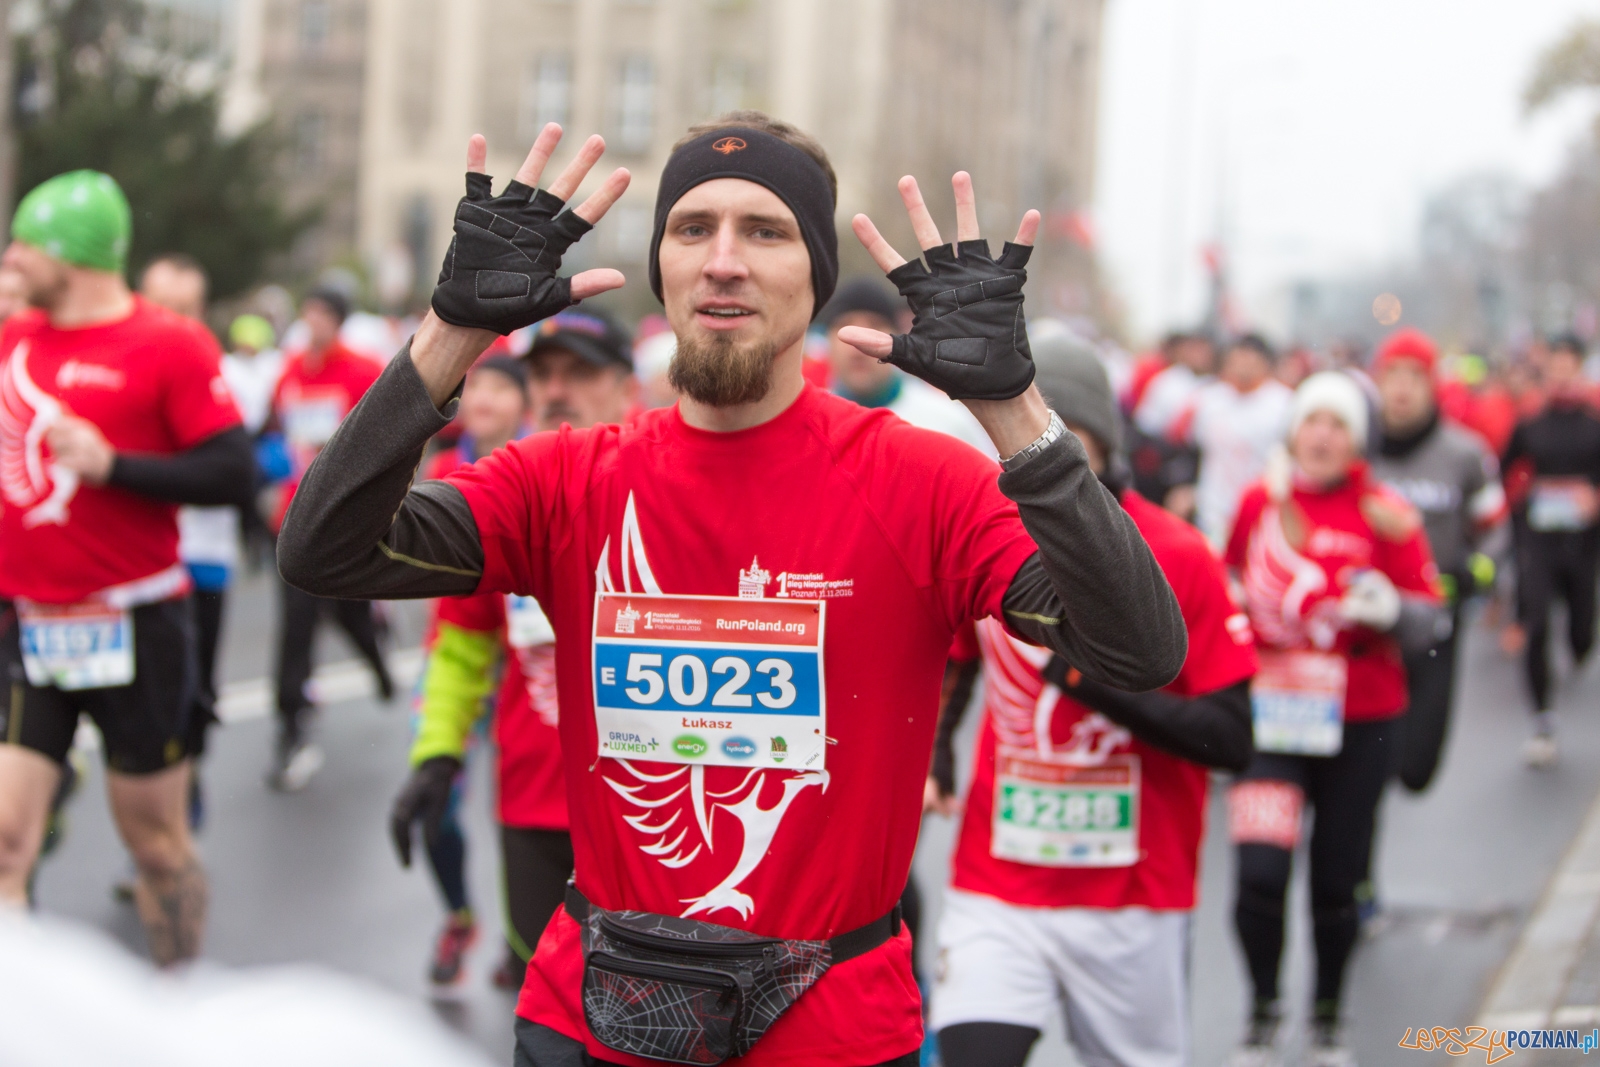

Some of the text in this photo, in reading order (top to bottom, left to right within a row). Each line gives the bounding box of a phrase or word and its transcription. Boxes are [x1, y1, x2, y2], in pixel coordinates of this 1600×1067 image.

[776, 571, 789, 597] 1
[787, 580, 803, 589] Bieg
[644, 611, 653, 630] 1
[716, 618, 806, 635] RunPoland.org
[601, 667, 616, 685] E
[625, 652, 797, 709] 5023
[682, 717, 733, 729] Łukasz
[609, 731, 641, 743] GRUPA
[609, 741, 647, 753] LUXMED
